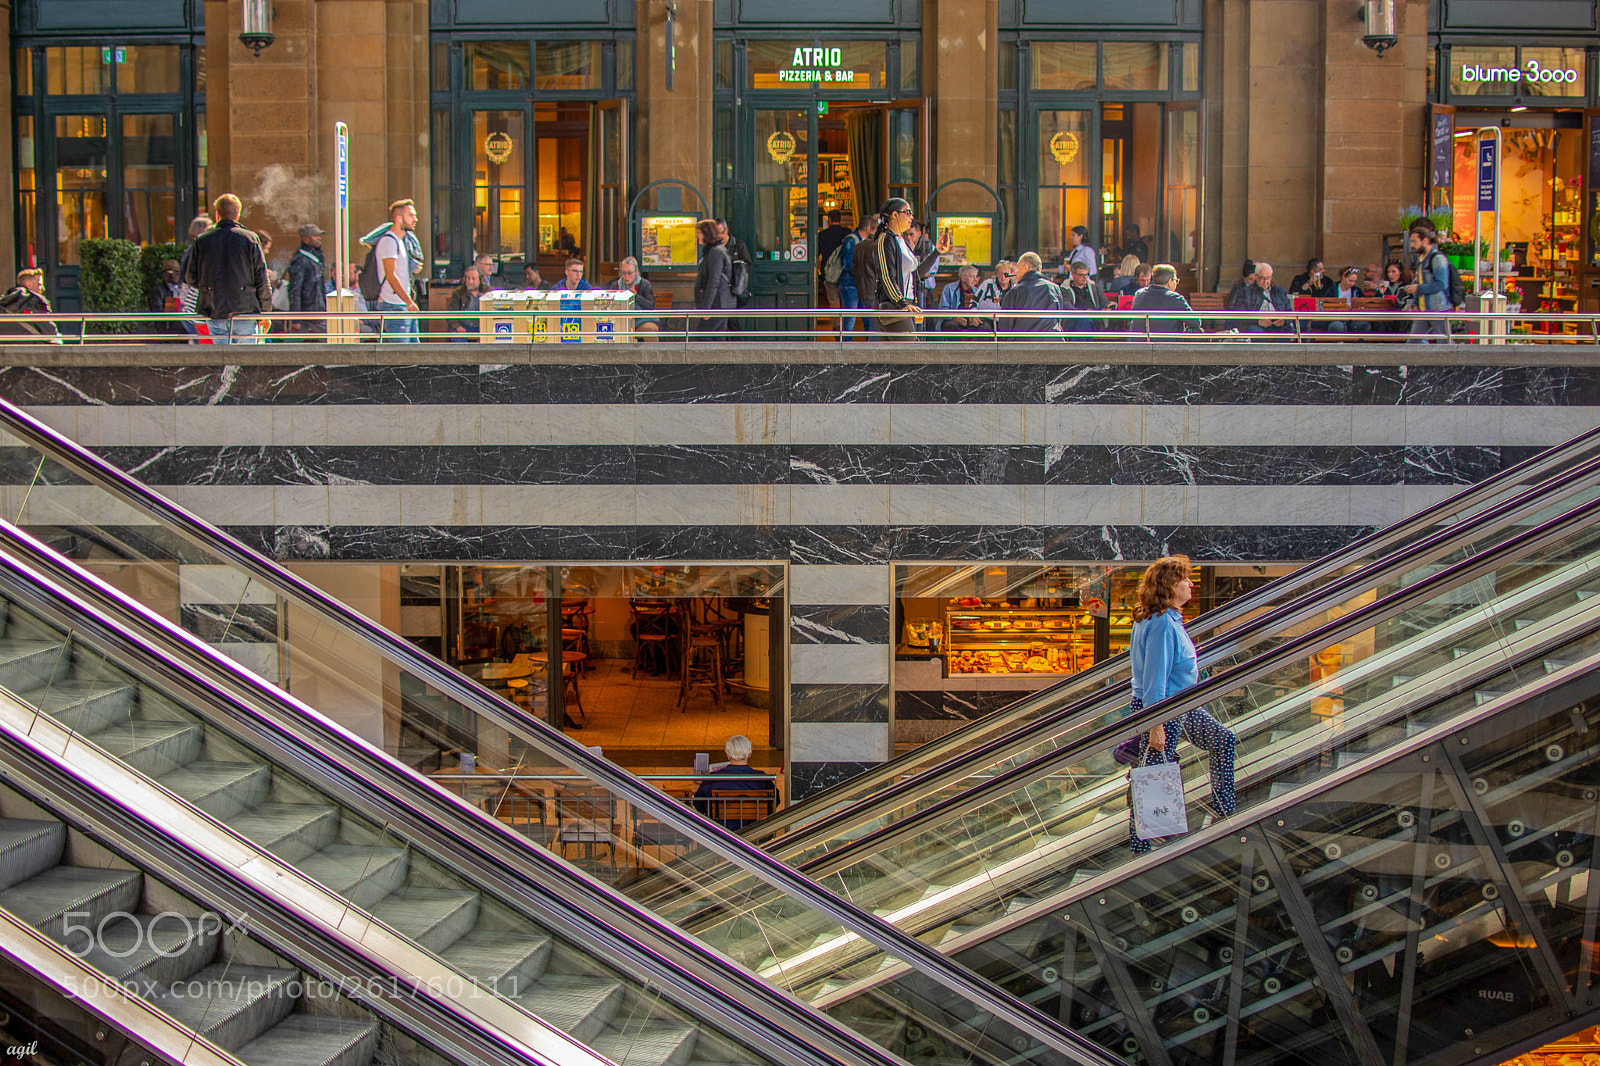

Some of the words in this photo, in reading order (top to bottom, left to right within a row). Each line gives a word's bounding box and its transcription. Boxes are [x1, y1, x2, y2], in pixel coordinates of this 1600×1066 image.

[792, 47, 842, 67] ATRIO
[779, 70, 822, 82] PIZZERIA
[824, 70, 833, 82] &
[835, 70, 854, 82] BAR
[1462, 64, 1522, 82] blume
[489, 140, 509, 149] ATRIO
[772, 140, 792, 149] ATRIO
[1055, 140, 1075, 149] ATRIO
